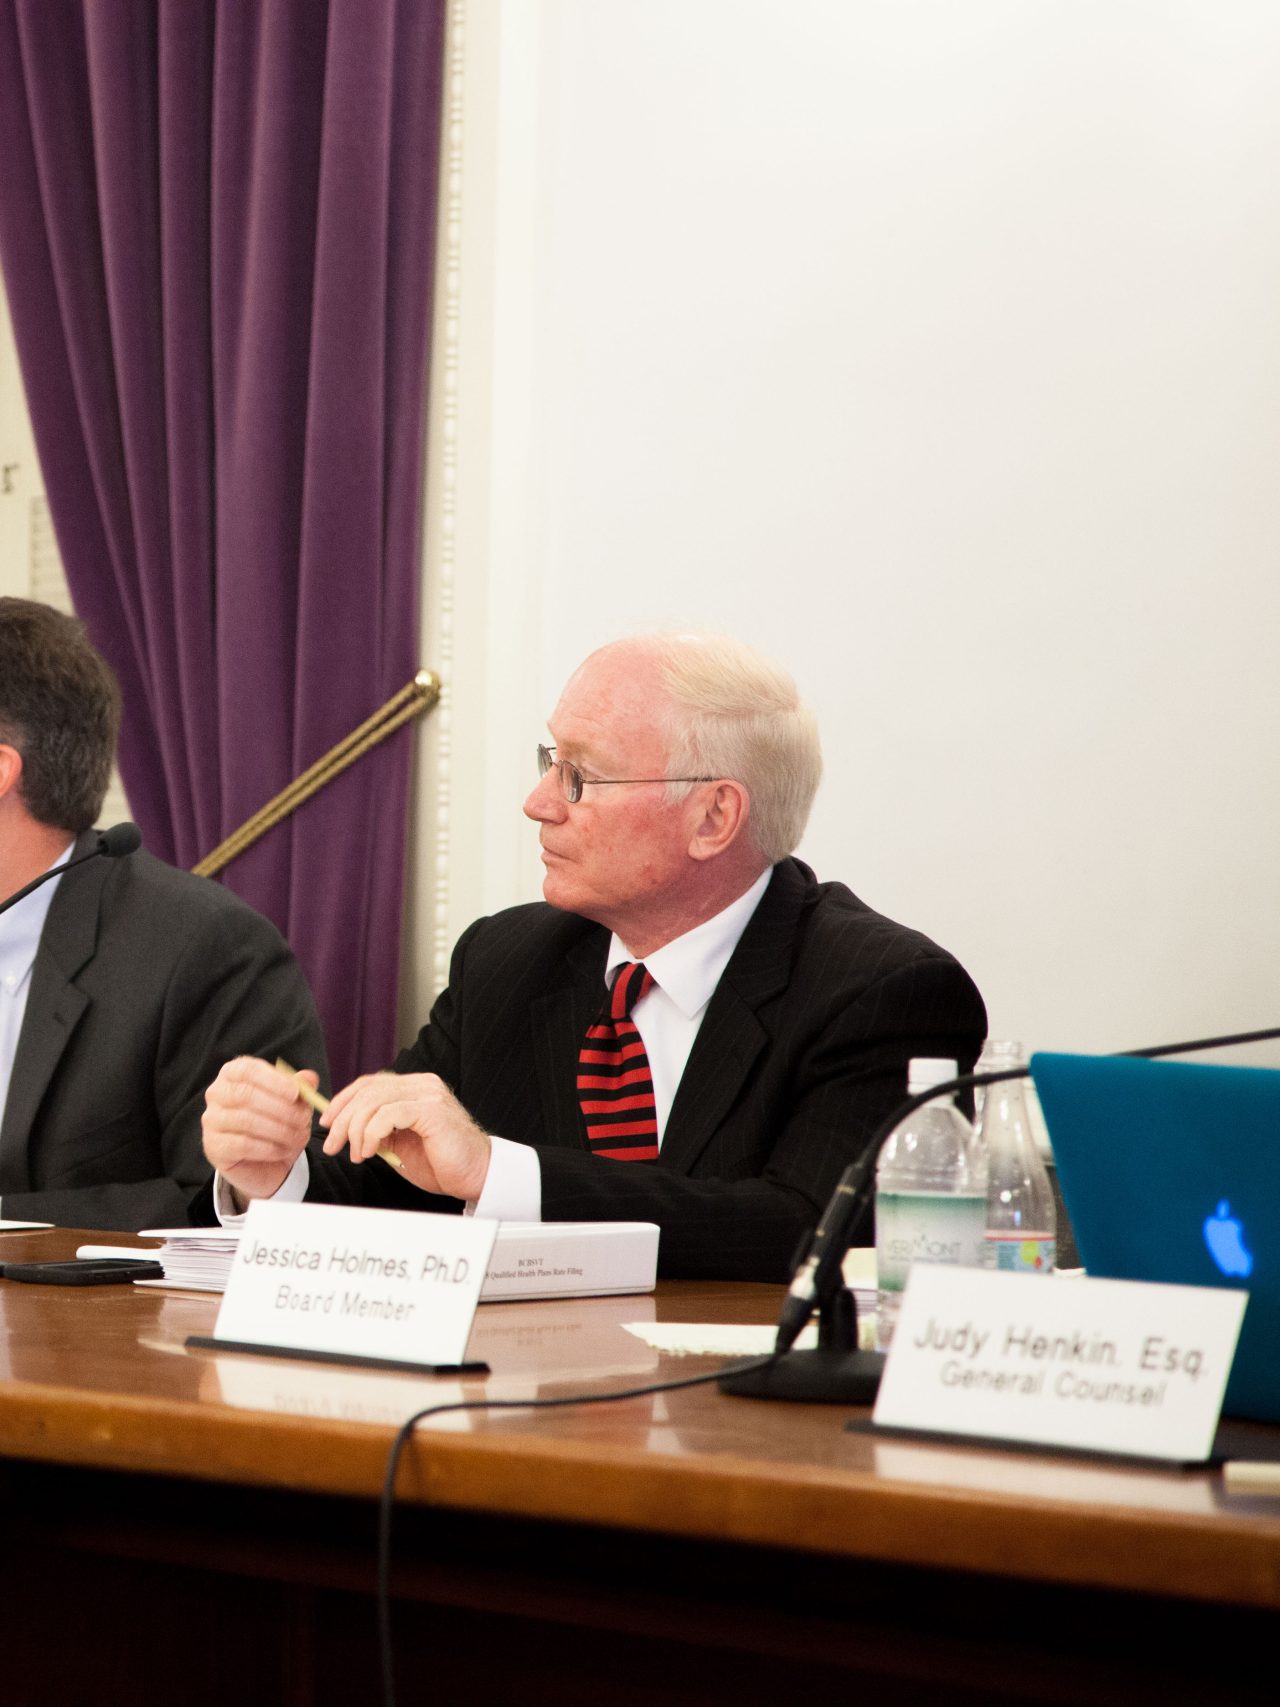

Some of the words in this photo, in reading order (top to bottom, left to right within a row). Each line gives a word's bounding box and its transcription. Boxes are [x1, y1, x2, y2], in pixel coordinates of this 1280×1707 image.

[243, 1240, 322, 1271] Jessica
[327, 1246, 411, 1282] Holmes,
[491, 1270, 516, 1280] Qualified
[517, 1270, 535, 1278] Health
[537, 1269, 552, 1277] Plans
[553, 1268, 566, 1276] Rate
[567, 1267, 583, 1276] Filing
[275, 1284, 335, 1315] Board
[340, 1291, 416, 1321] Member
[914, 1318, 990, 1358] Judy
[939, 1360, 1045, 1396] General
[1053, 1370, 1167, 1408] Counsel
